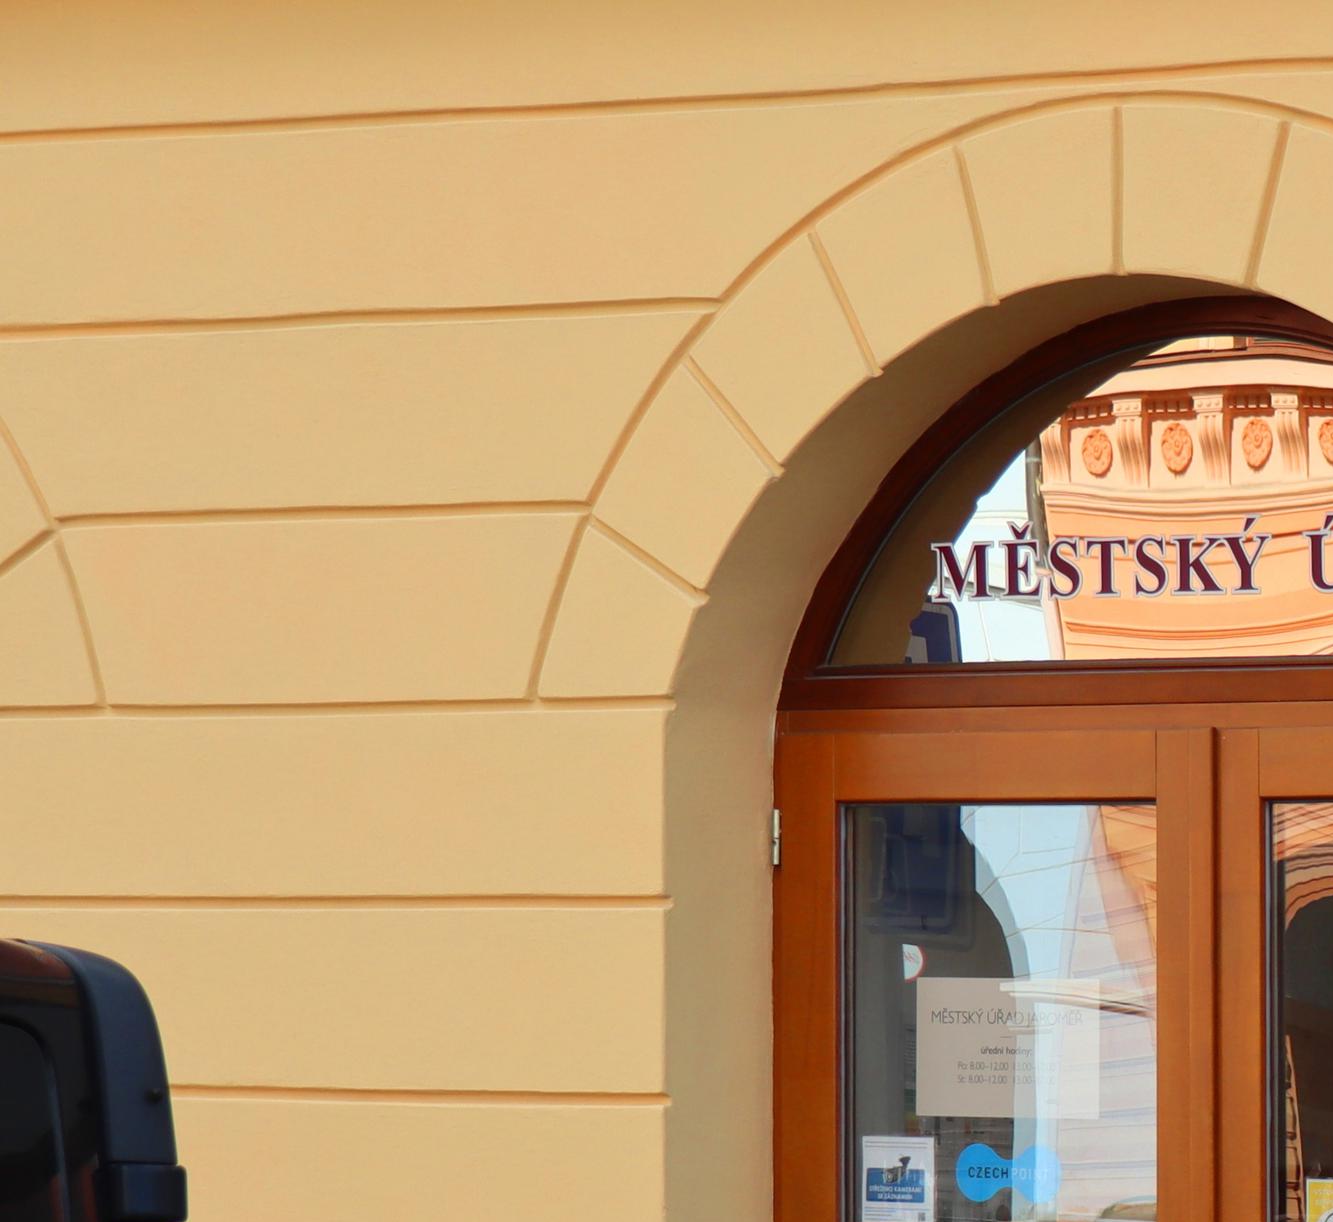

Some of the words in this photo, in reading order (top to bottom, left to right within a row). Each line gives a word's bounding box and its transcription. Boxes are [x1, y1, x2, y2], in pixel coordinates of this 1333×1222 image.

[930, 513, 1271, 604] MĚSTSKÝ
[930, 1007, 984, 1025] MĚSTSKÝ
[986, 1007, 1024, 1025] ÚŘAD
[1026, 1008, 1083, 1027] JAROMĚŘ
[980, 1045, 1004, 1055] úřední
[967, 1166, 1009, 1179] CZECH
